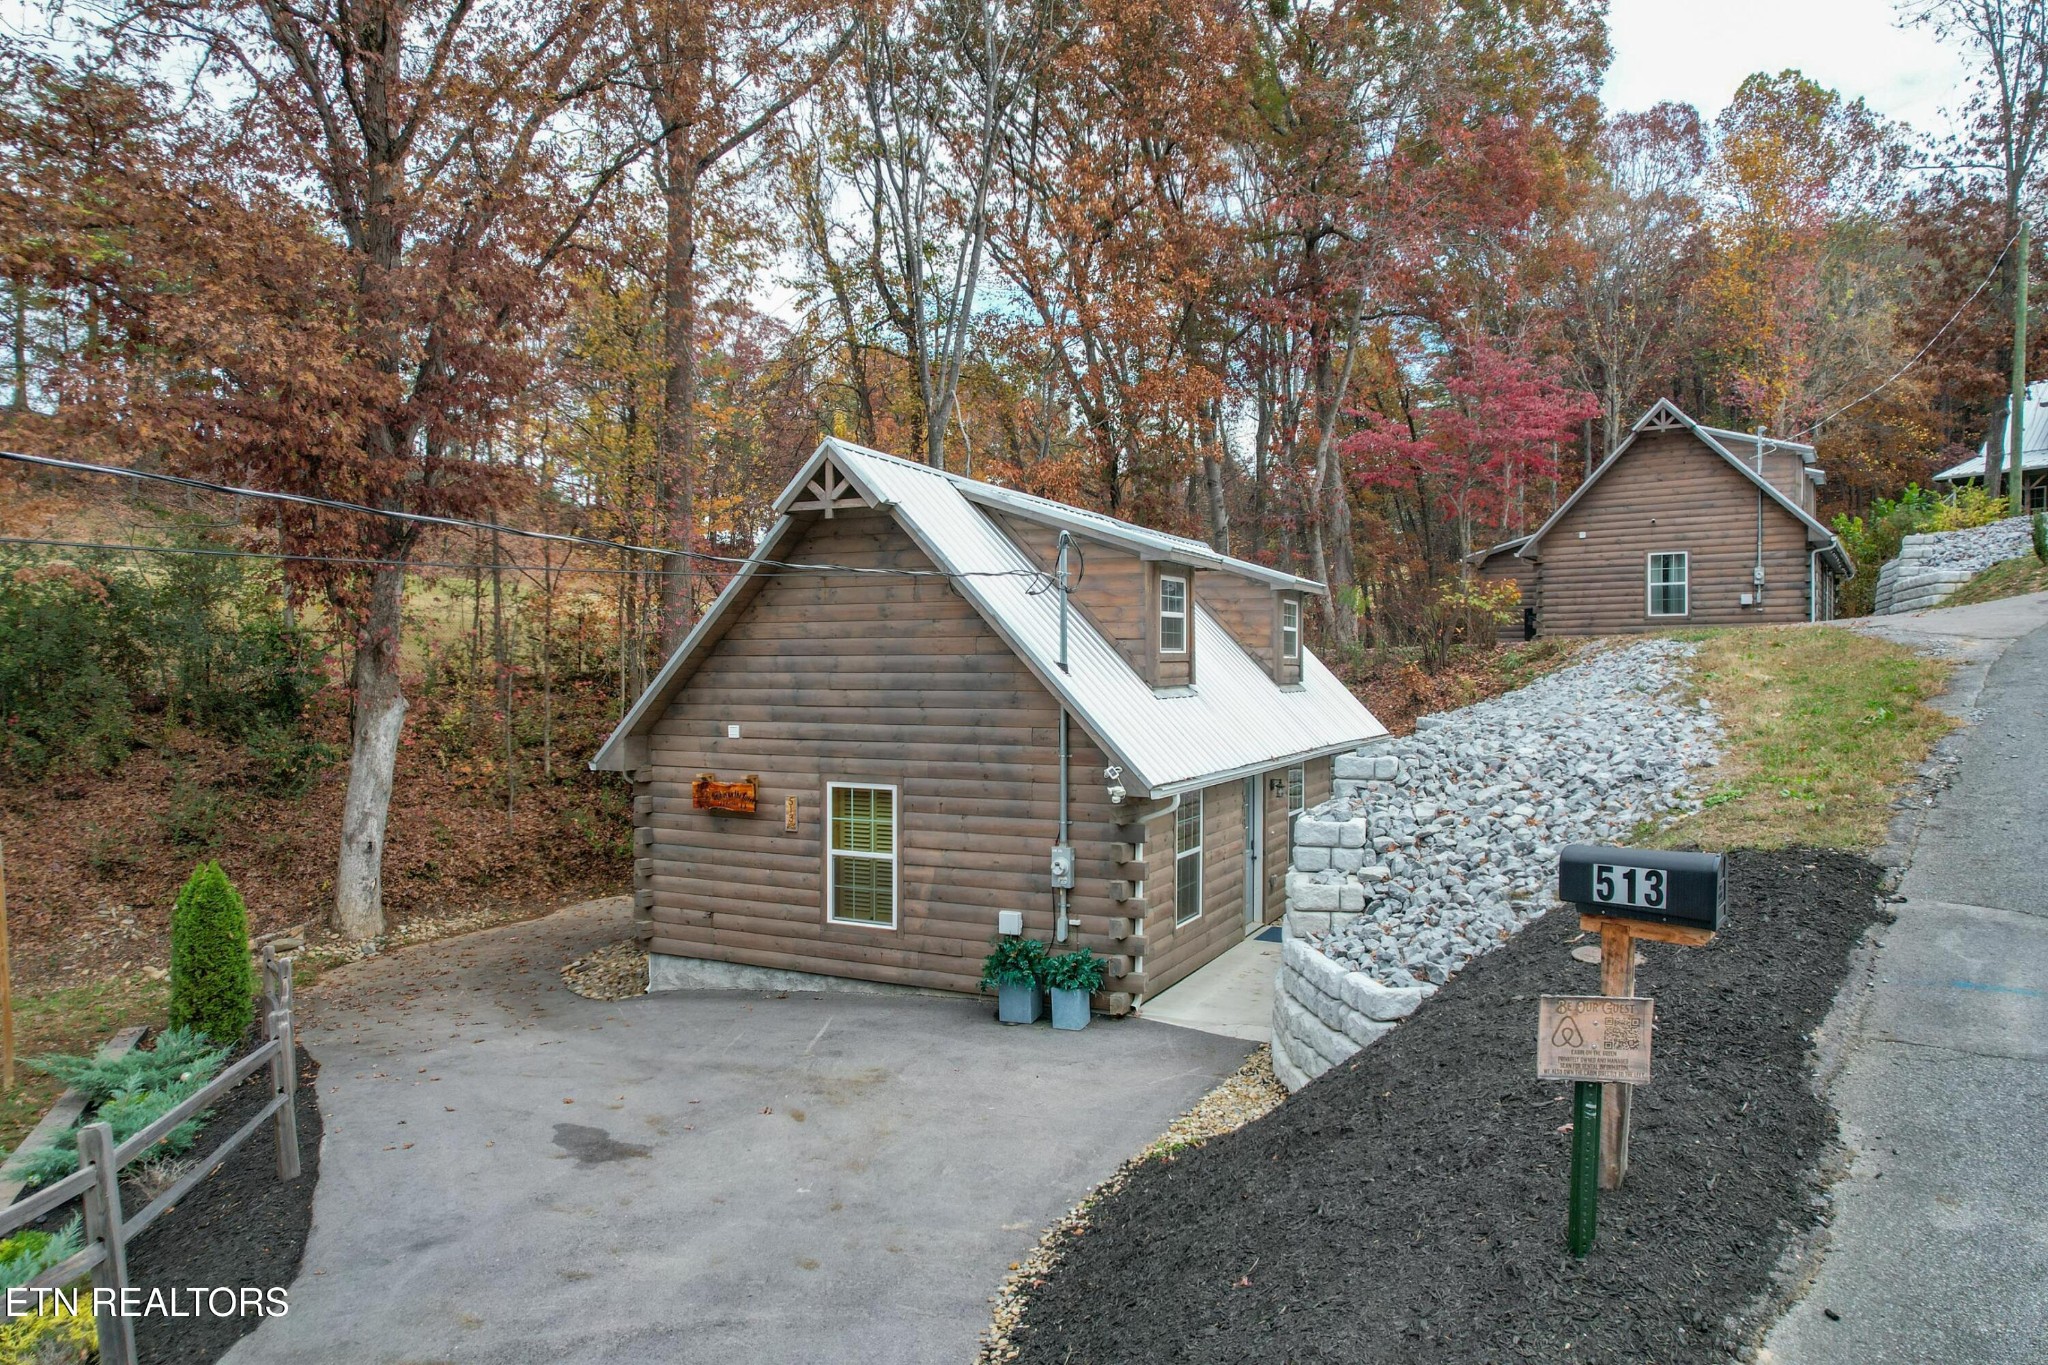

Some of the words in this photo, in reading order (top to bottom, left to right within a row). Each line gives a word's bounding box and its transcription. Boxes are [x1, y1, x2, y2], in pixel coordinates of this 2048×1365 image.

[1597, 865, 1664, 907] 513
[1576, 1000, 1599, 1014] OUR
[1602, 1001, 1635, 1015] GUEST
